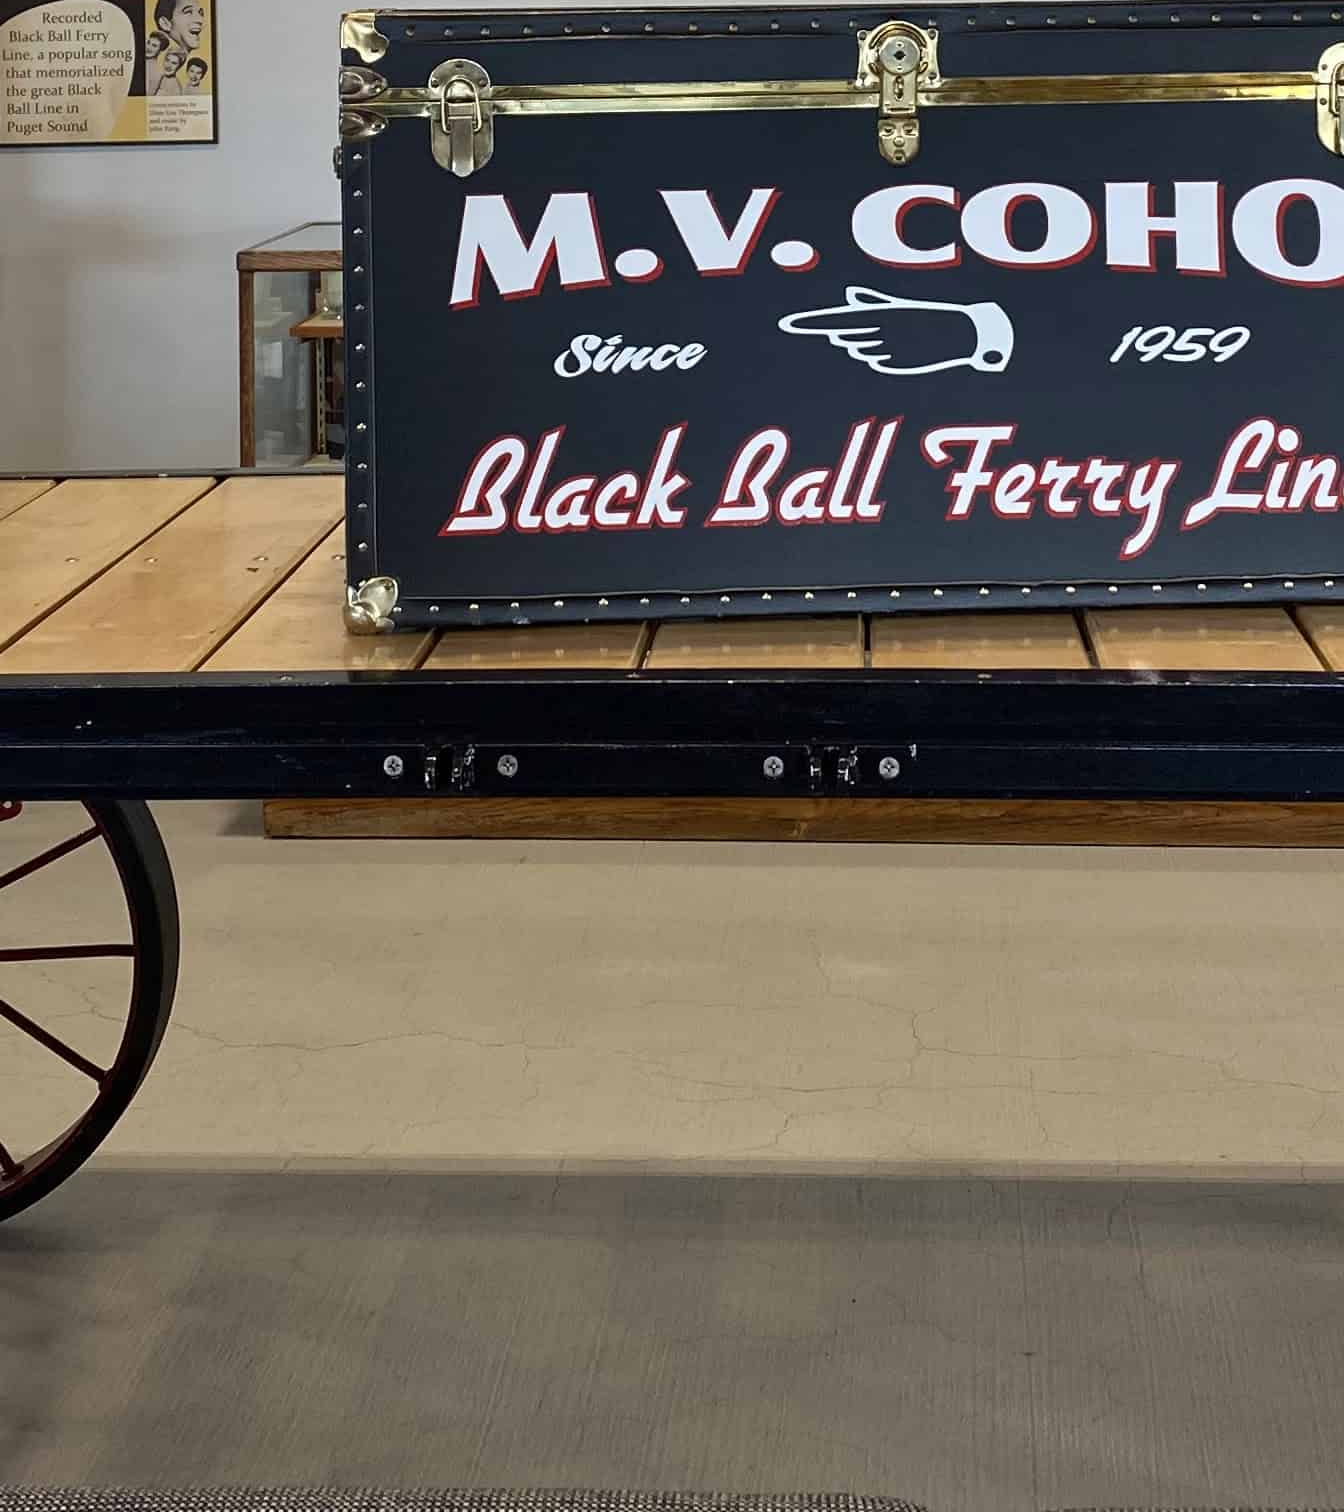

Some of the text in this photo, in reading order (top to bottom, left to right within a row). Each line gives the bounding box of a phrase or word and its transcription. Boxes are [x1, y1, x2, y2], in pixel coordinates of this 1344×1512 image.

[41, 11, 102, 23] Recorded
[9, 29, 109, 44] Black Ball Ferry
[37, 52, 43, 60] a
[48, 47, 98, 63] popular
[101, 50, 133, 62] song
[5, 65, 123, 78] that memorialized
[5, 83, 102, 99] the great Black
[6, 102, 79, 114] Ball Line in
[6, 120, 87, 136] Puget Sound
[447, 185, 820, 311] M.V.
[552, 324, 1251, 381] Since 1959
[438, 419, 694, 537] Black
[702, 415, 905, 530] Ball
[918, 420, 1181, 561] Ferry
